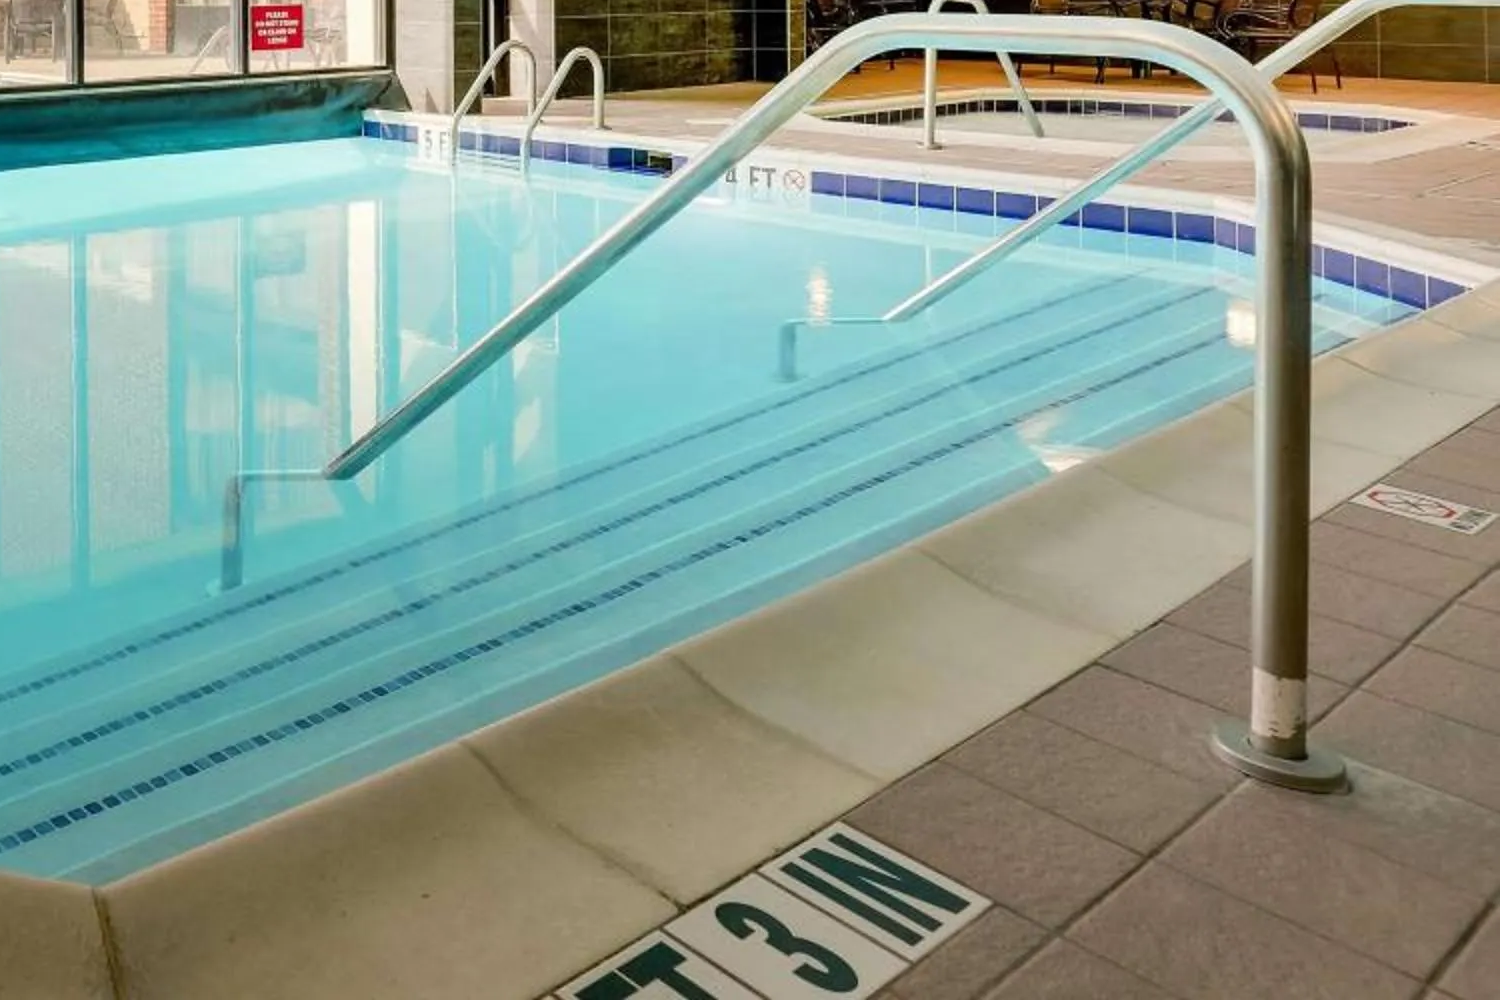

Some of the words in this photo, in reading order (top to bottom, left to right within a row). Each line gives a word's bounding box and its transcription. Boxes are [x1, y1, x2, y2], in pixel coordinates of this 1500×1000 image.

[749, 166, 776, 189] FT
[779, 832, 972, 947] IN
[714, 901, 859, 993] 3
